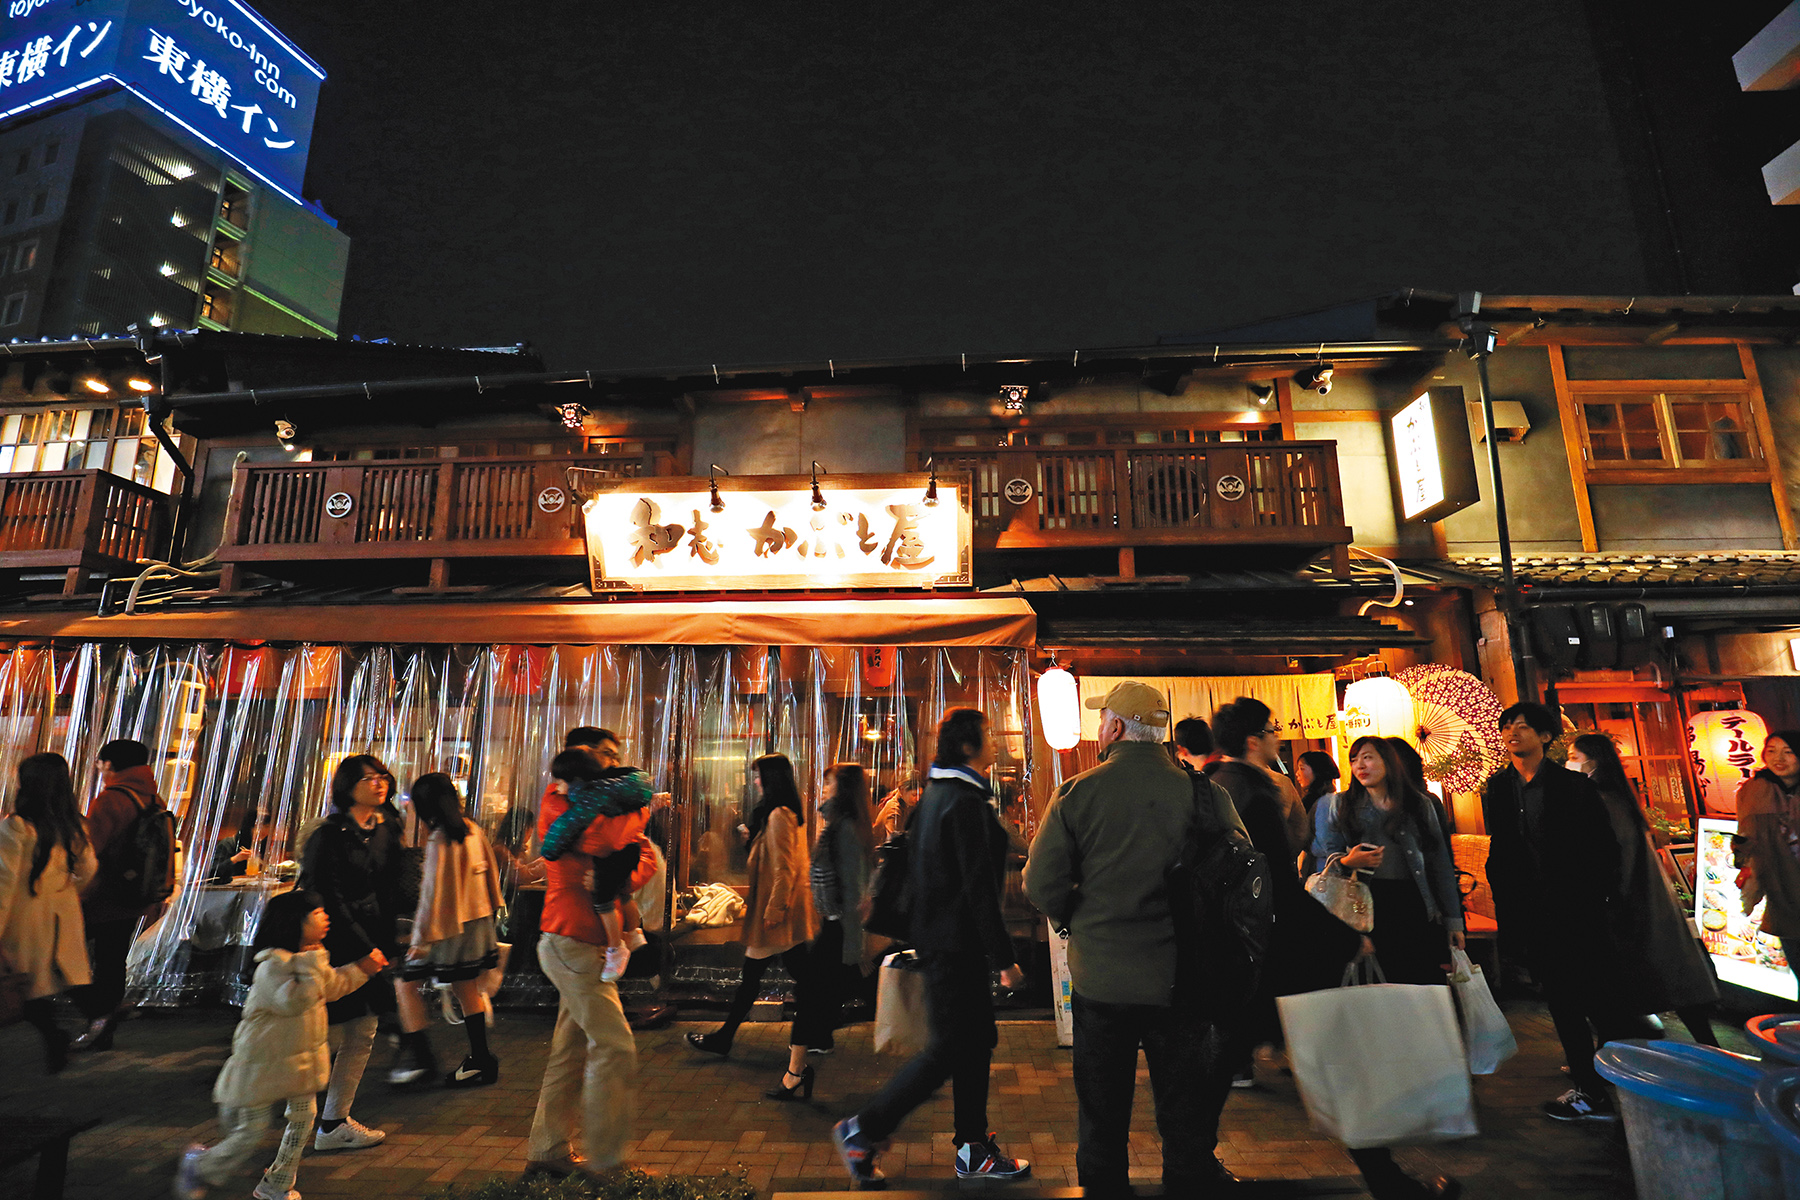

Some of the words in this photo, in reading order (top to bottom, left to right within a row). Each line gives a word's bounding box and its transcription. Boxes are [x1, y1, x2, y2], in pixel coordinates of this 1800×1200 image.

[142, 28, 296, 149] 東横イン
[745, 503, 936, 571] かぶと屋
[1288, 713, 1338, 730] かぶと屋
[1720, 716, 1756, 787] テールラー
